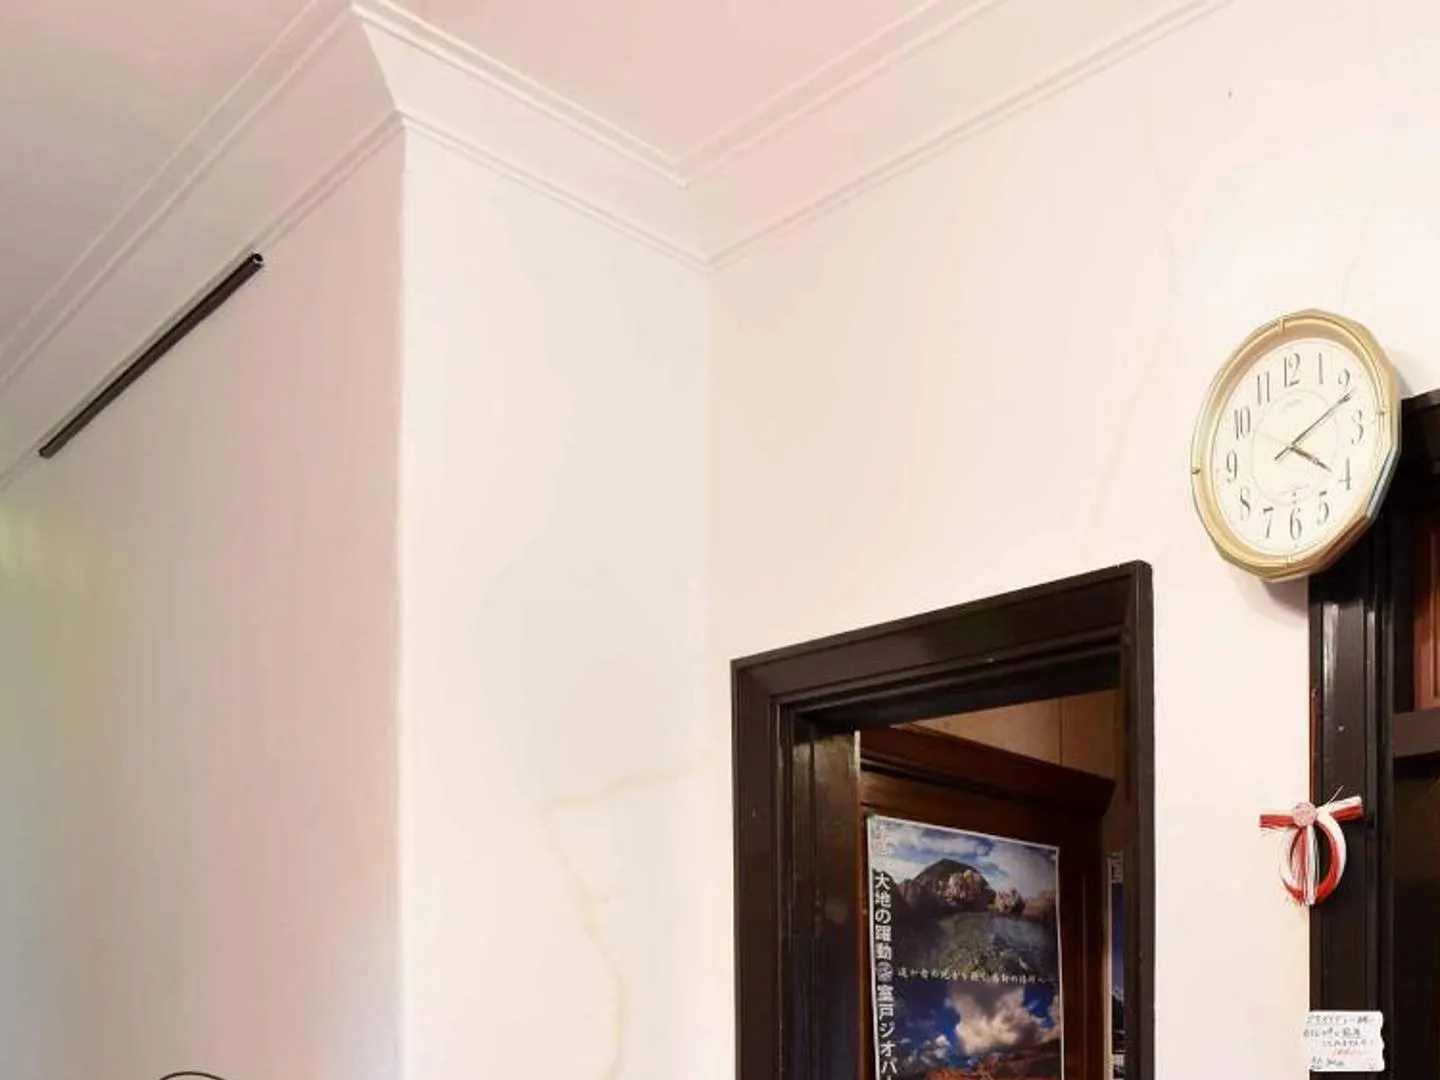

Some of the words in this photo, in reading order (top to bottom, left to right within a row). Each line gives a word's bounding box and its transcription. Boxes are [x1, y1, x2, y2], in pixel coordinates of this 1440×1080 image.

[1256, 371, 1271, 405] 11
[1284, 353, 1301, 388] 12
[1233, 406, 1251, 440] 10
[1351, 409, 1364, 445] 3
[1225, 449, 1238, 484] 9
[1338, 456, 1352, 491] 4
[1239, 487, 1252, 522] 8
[1316, 490, 1329, 526] 5
[1262, 506, 1274, 539] 7
[1289, 507, 1302, 540] 6
